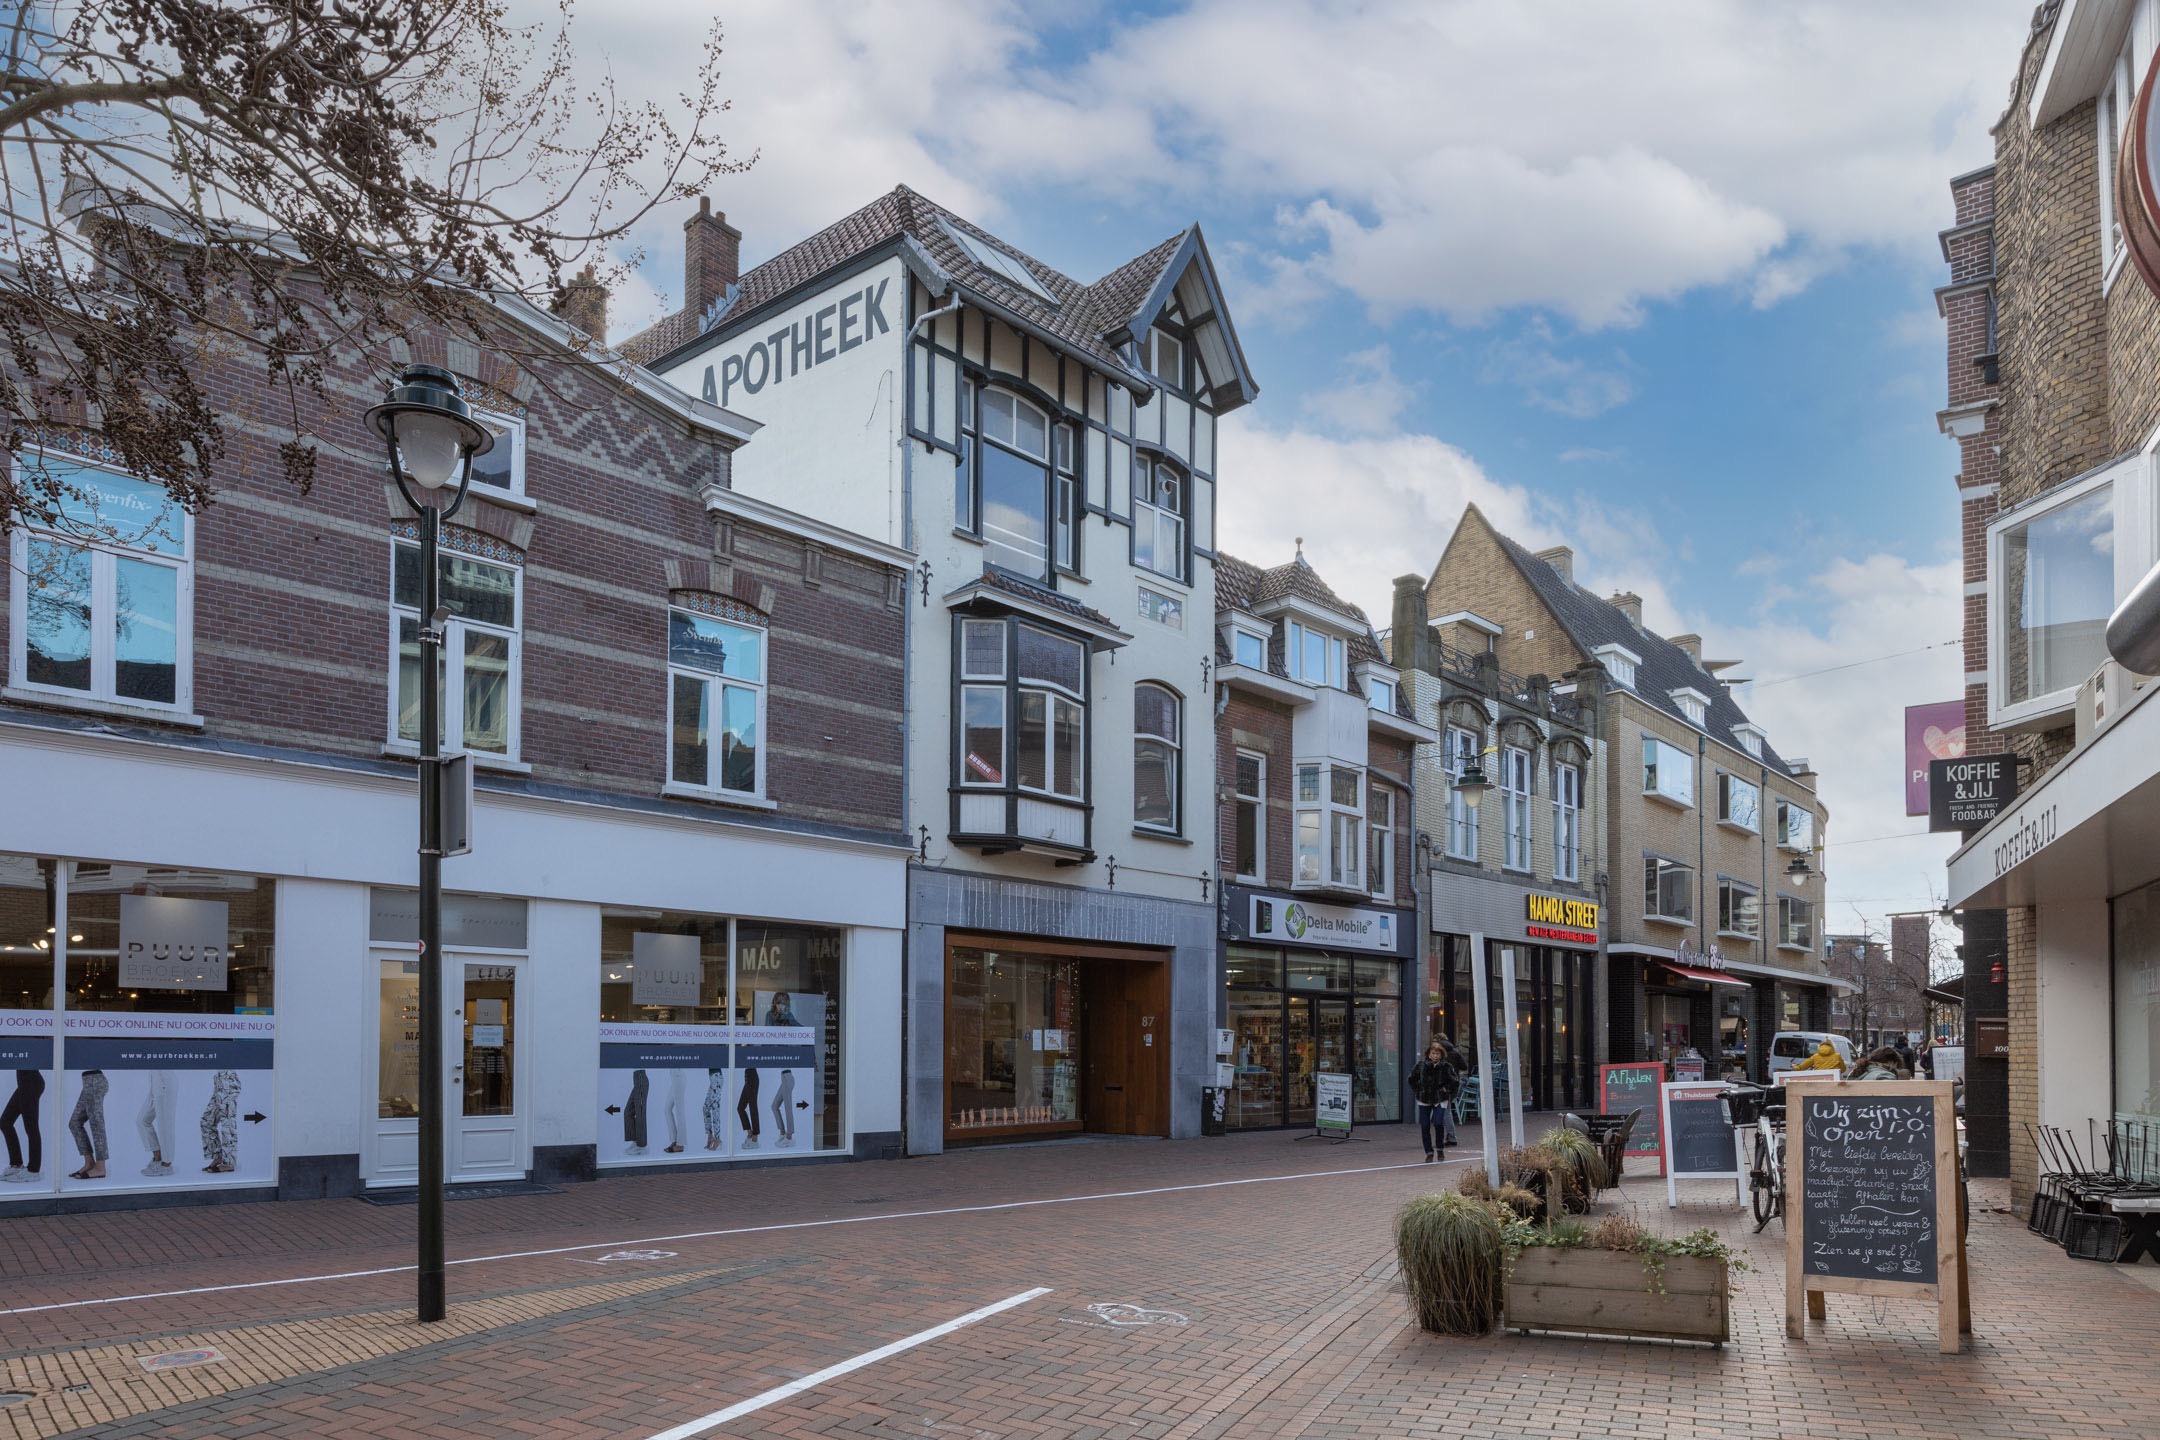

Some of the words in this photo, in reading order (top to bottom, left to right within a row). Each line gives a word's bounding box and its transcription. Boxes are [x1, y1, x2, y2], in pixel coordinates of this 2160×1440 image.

[702, 277, 889, 407] APOTHEEK
[1946, 762, 2000, 781] KOFFIE
[1955, 782, 1993, 799] &JIJ
[1952, 809, 1996, 821] FOODBAR
[1529, 893, 1564, 924] HAMRA
[1566, 900, 1598, 929] STREET
[1307, 916, 1333, 930] Delta
[1336, 919, 1368, 934] Mobile
[1529, 925, 1539, 937] NEW
[1540, 927, 1549, 938] AGE
[128, 942, 219, 963] PUUR
[742, 946, 781, 971] MAC
[127, 964, 220, 979] BROEKEN
[6, 1017, 32, 1027] OOK
[79, 1019, 95, 1028] NU
[98, 1019, 122, 1028] OOK
[125, 1020, 164, 1029] ONLINE
[166, 1021, 181, 1029] NU
[184, 1021, 207, 1029] OOK
[209, 1021, 247, 1031] ONLINE
[248, 1022, 262, 1030] NU
[1142, 1016, 1155, 1027] 87
[615, 1029, 640, 1037] ONLINE
[668, 1030, 693, 1038] ONLINE
[1995, 1045, 2009, 1053] 100
[1813, 1101, 1850, 1127] Wij
[1856, 1105, 1900, 1129] zijn
[1640, 1142, 1659, 1151] OPEN
[1810, 1146, 1833, 1158] Met
[1844, 1145, 1877, 1165] liefde
[1881, 1146, 1923, 1161] bereiden
[1808, 1159, 1818, 1172] &
[1820, 1161, 1866, 1181] bezorgen
[1874, 1167, 1888, 1180] wij
[1856, 1190, 1895, 1204] Afhalen
[1901, 1191, 1919, 1203] kan
[1840, 1214, 1866, 1225] hebben
[1869, 1216, 1888, 1226] veel
[1893, 1220, 1920, 1235] vegan
[1922, 1217, 1931, 1229] &
[1813, 1242, 1843, 1255] Zien
[1862, 1247, 1874, 1264] je
[1877, 1244, 1896, 1256] snel
